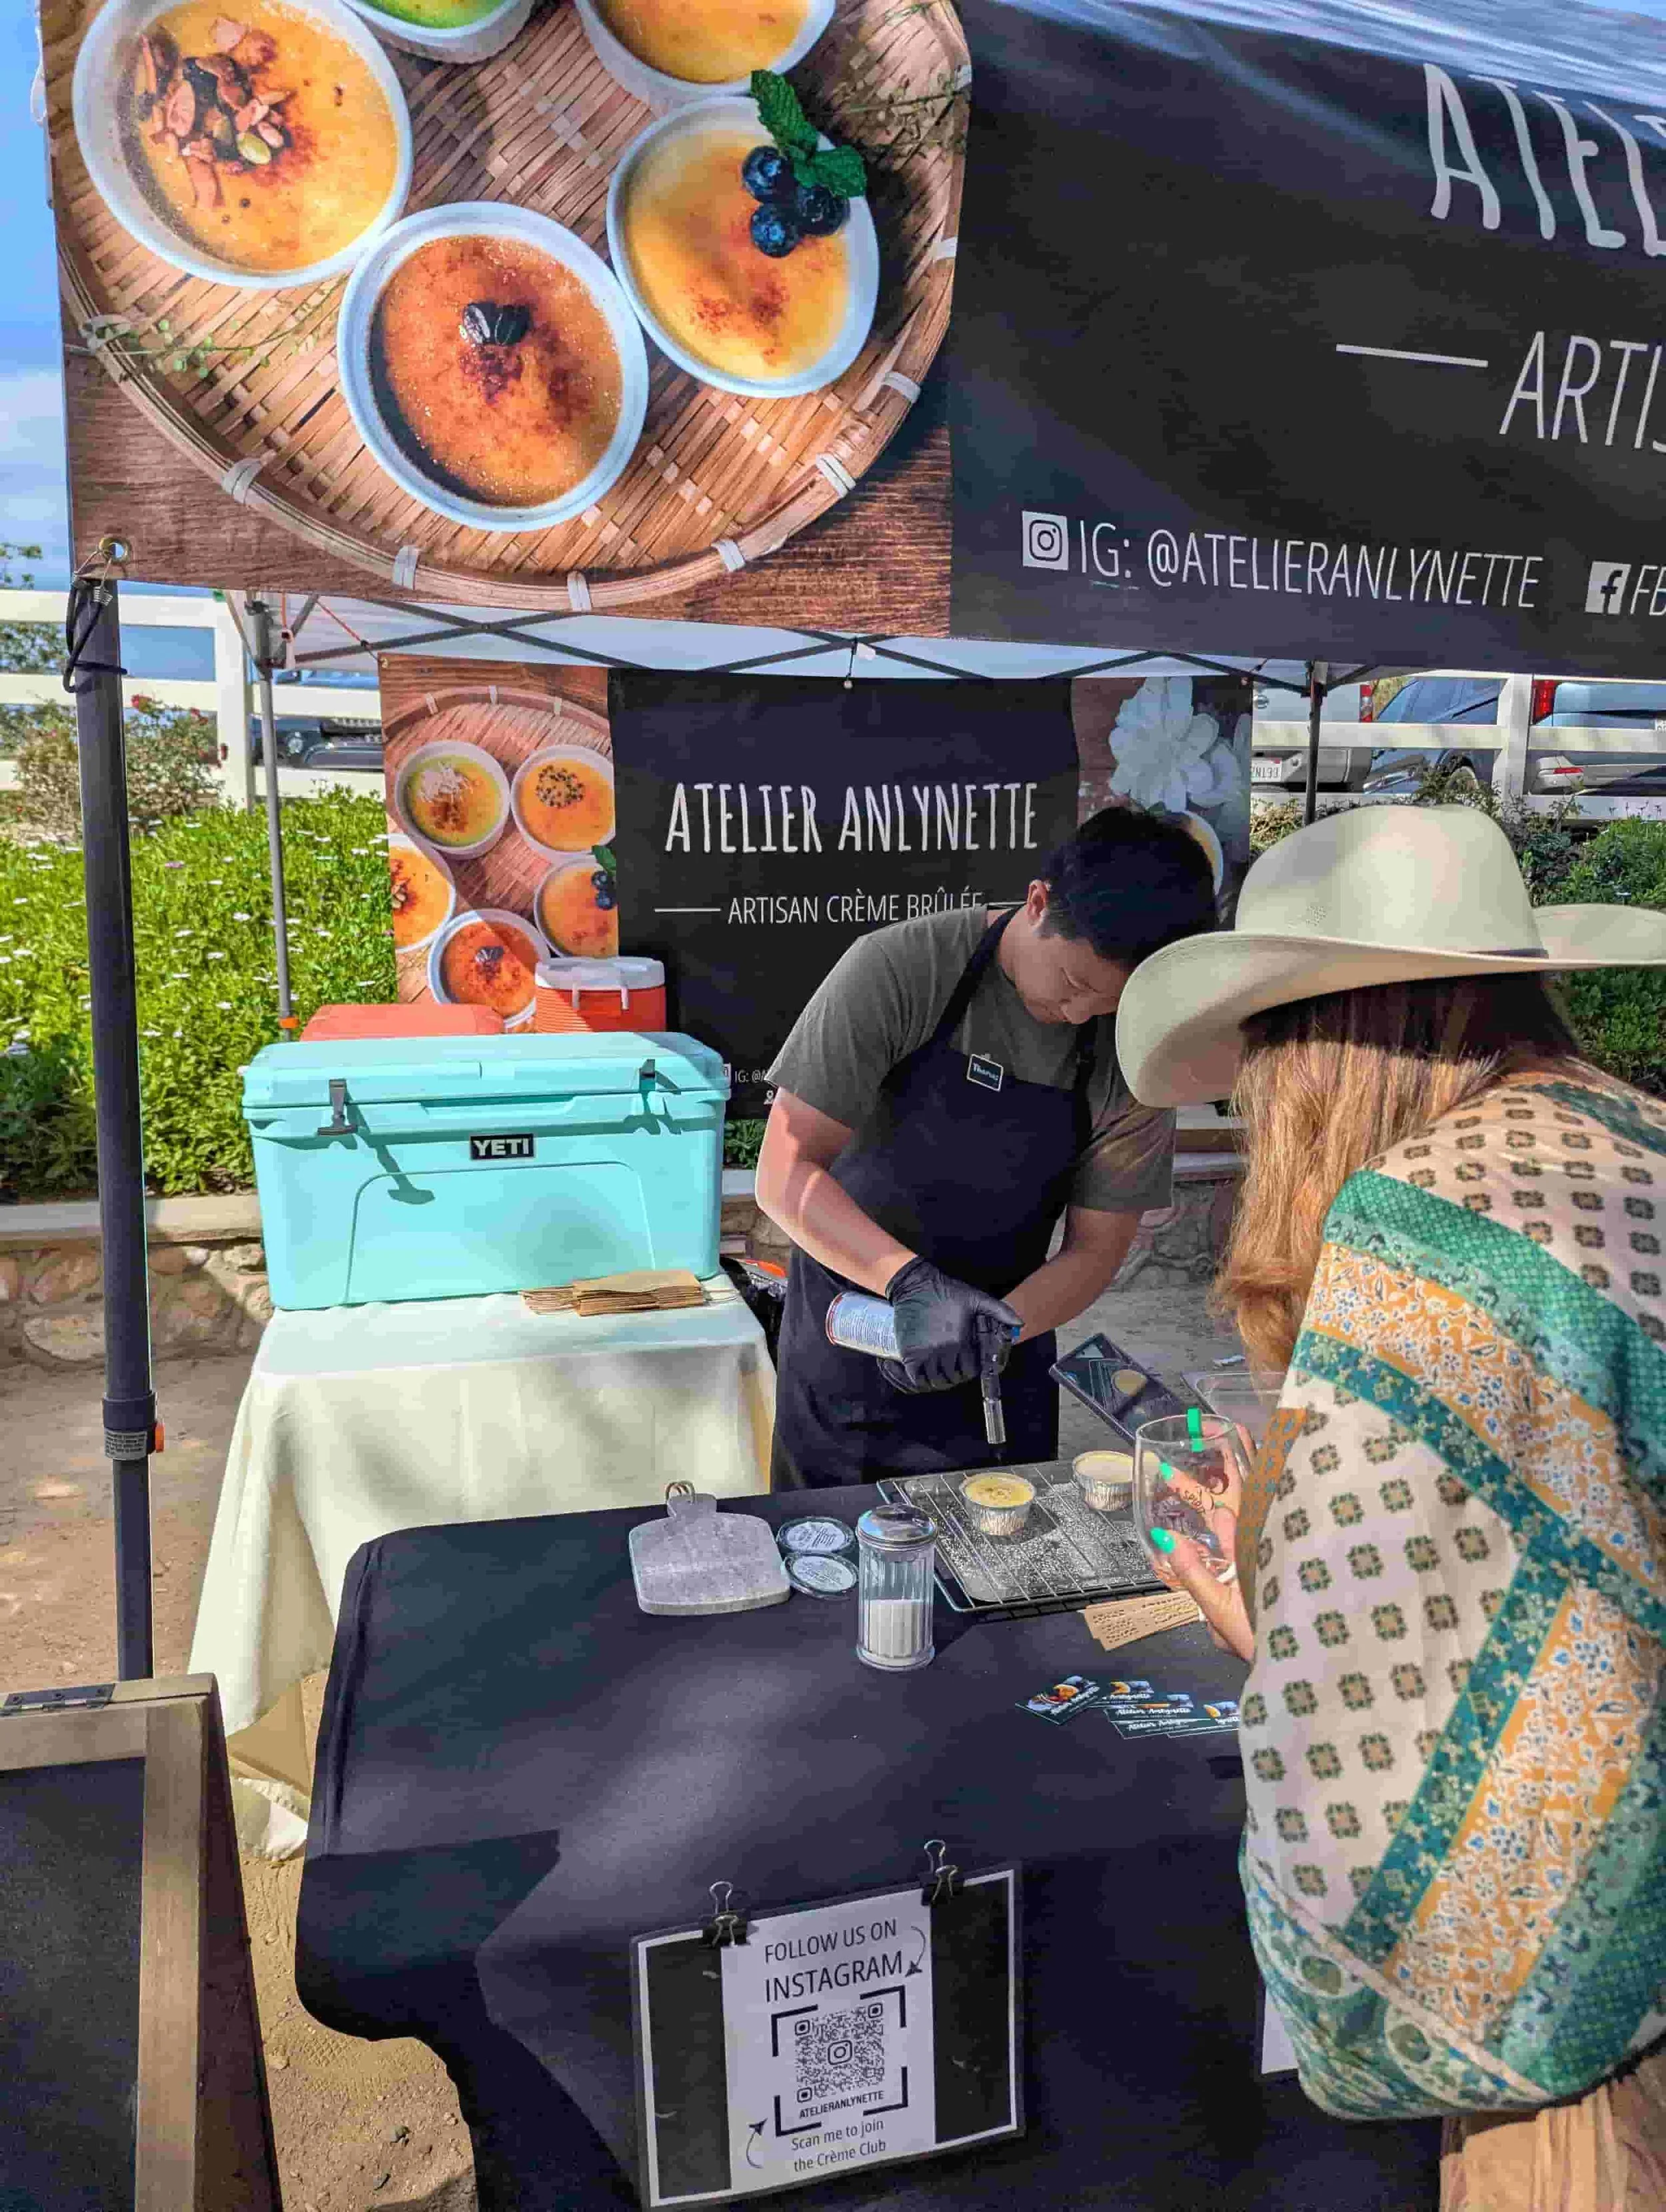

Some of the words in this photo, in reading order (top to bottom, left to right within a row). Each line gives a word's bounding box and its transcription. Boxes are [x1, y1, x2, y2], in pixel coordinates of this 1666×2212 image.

[1423, 63, 1666, 257] ATEL
[1080, 520, 1132, 579] IG:
[1148, 528, 1543, 608] @ATELIERANLYNETTE
[665, 782, 823, 853] ATELIER
[838, 782, 1038, 852] ANLYNETTE
[728, 896, 819, 924] ARTISAN
[826, 887, 900, 923] CRÈME
[735, 1069, 749, 1083] IG:
[472, 1138, 529, 1156] YETI
[766, 1932, 838, 1963] FOLLOW
[843, 1926, 866, 1947] US
[871, 1918, 897, 1940] ON
[766, 1950, 902, 2003] INSTAGRAM
[800, 2091, 884, 2118] ATELIERANLYNETTE
[792, 2135, 820, 2151] Scan
[824, 2129, 842, 2143] me
[846, 2124, 858, 2136] to
[861, 2118, 884, 2139] join
[794, 2158, 814, 2172] the
[817, 2147, 856, 2167] Crème
[860, 2139, 886, 2156] Club
